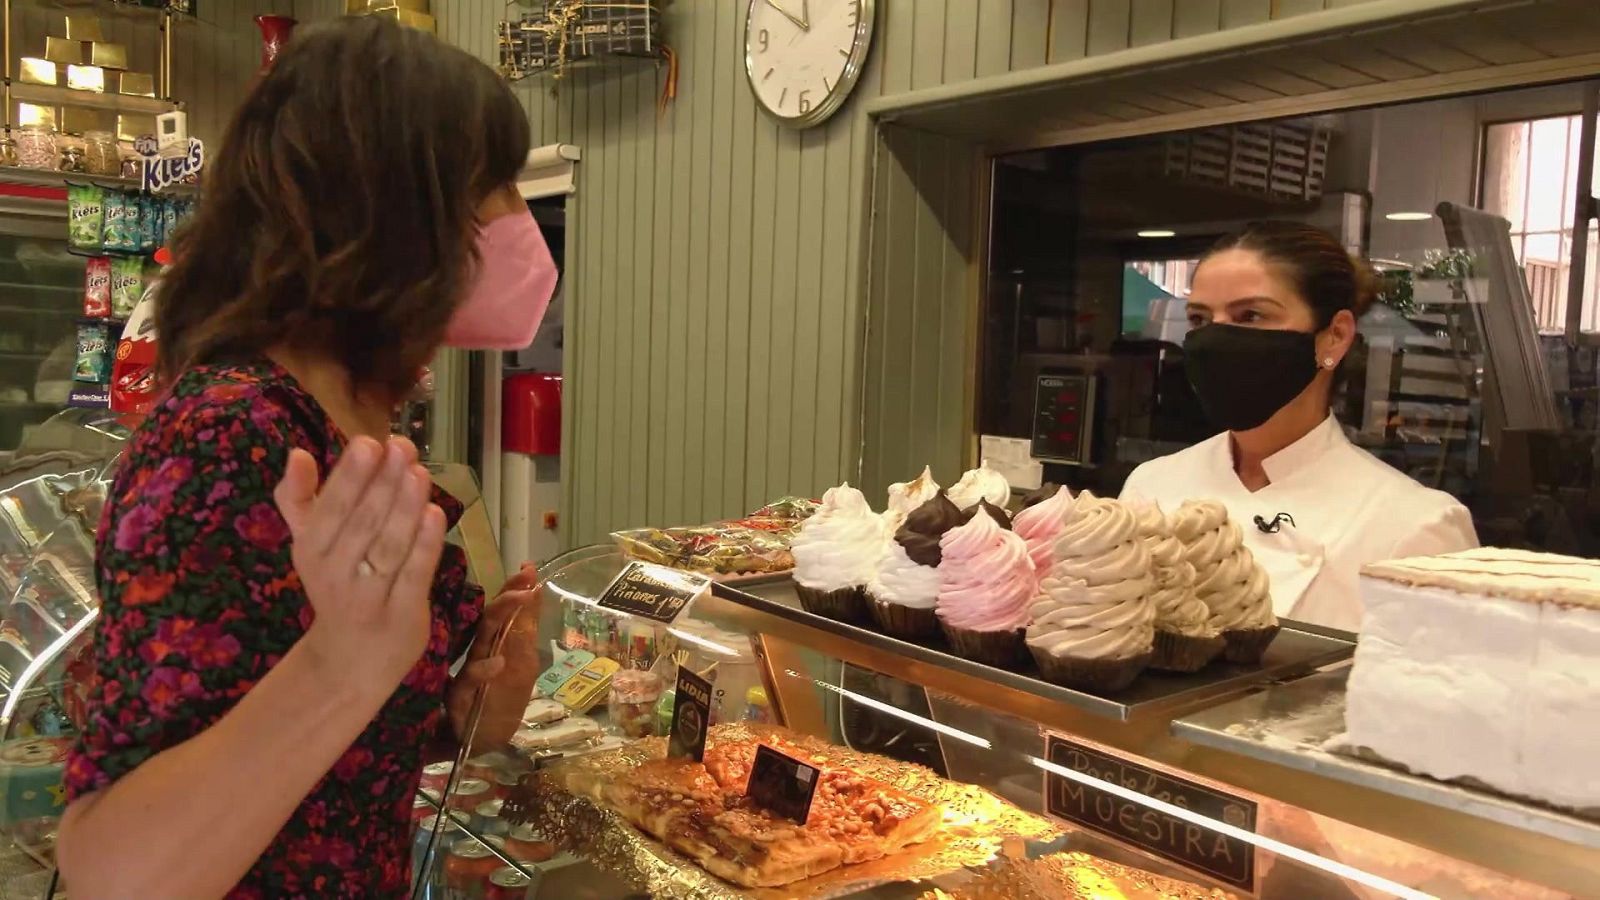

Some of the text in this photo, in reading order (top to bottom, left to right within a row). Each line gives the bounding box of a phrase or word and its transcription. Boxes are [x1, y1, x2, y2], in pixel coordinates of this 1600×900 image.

[759, 28, 769, 53] 9
[799, 89, 810, 114] 6
[679, 679, 709, 706] LIDIA
[1060, 780, 1233, 863] MUESTRA
